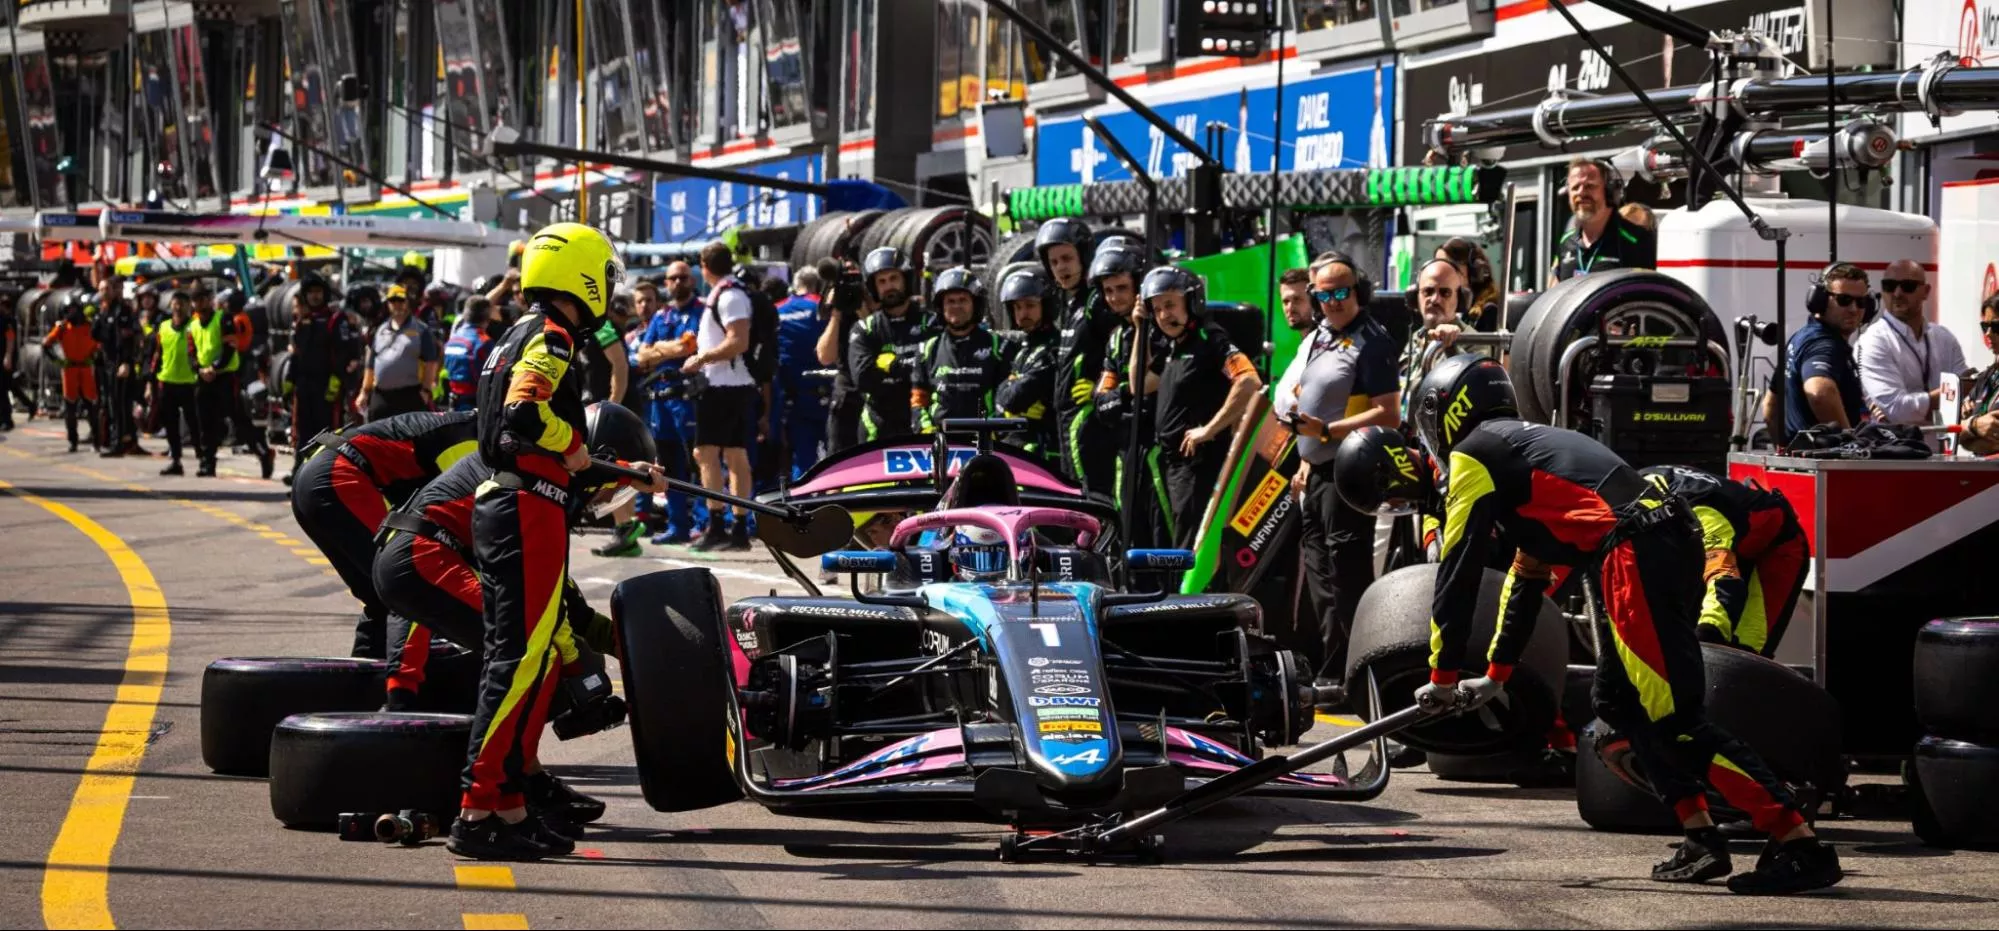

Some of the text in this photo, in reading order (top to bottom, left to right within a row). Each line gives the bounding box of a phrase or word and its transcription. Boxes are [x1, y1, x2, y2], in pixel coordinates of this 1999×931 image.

[580, 272, 602, 303] ART
[1441, 384, 1474, 445] ART
[1384, 444, 1420, 483] ART
[532, 480, 570, 505] MRTC
[1237, 475, 1282, 529] PIRELLI
[790, 605, 887, 617] RICHARD MILLE
[1128, 601, 1217, 614] RICHARD MILLE
[923, 628, 950, 657] CORUM
[1029, 623, 1061, 647] 1
[1050, 696, 1101, 706] BWT
